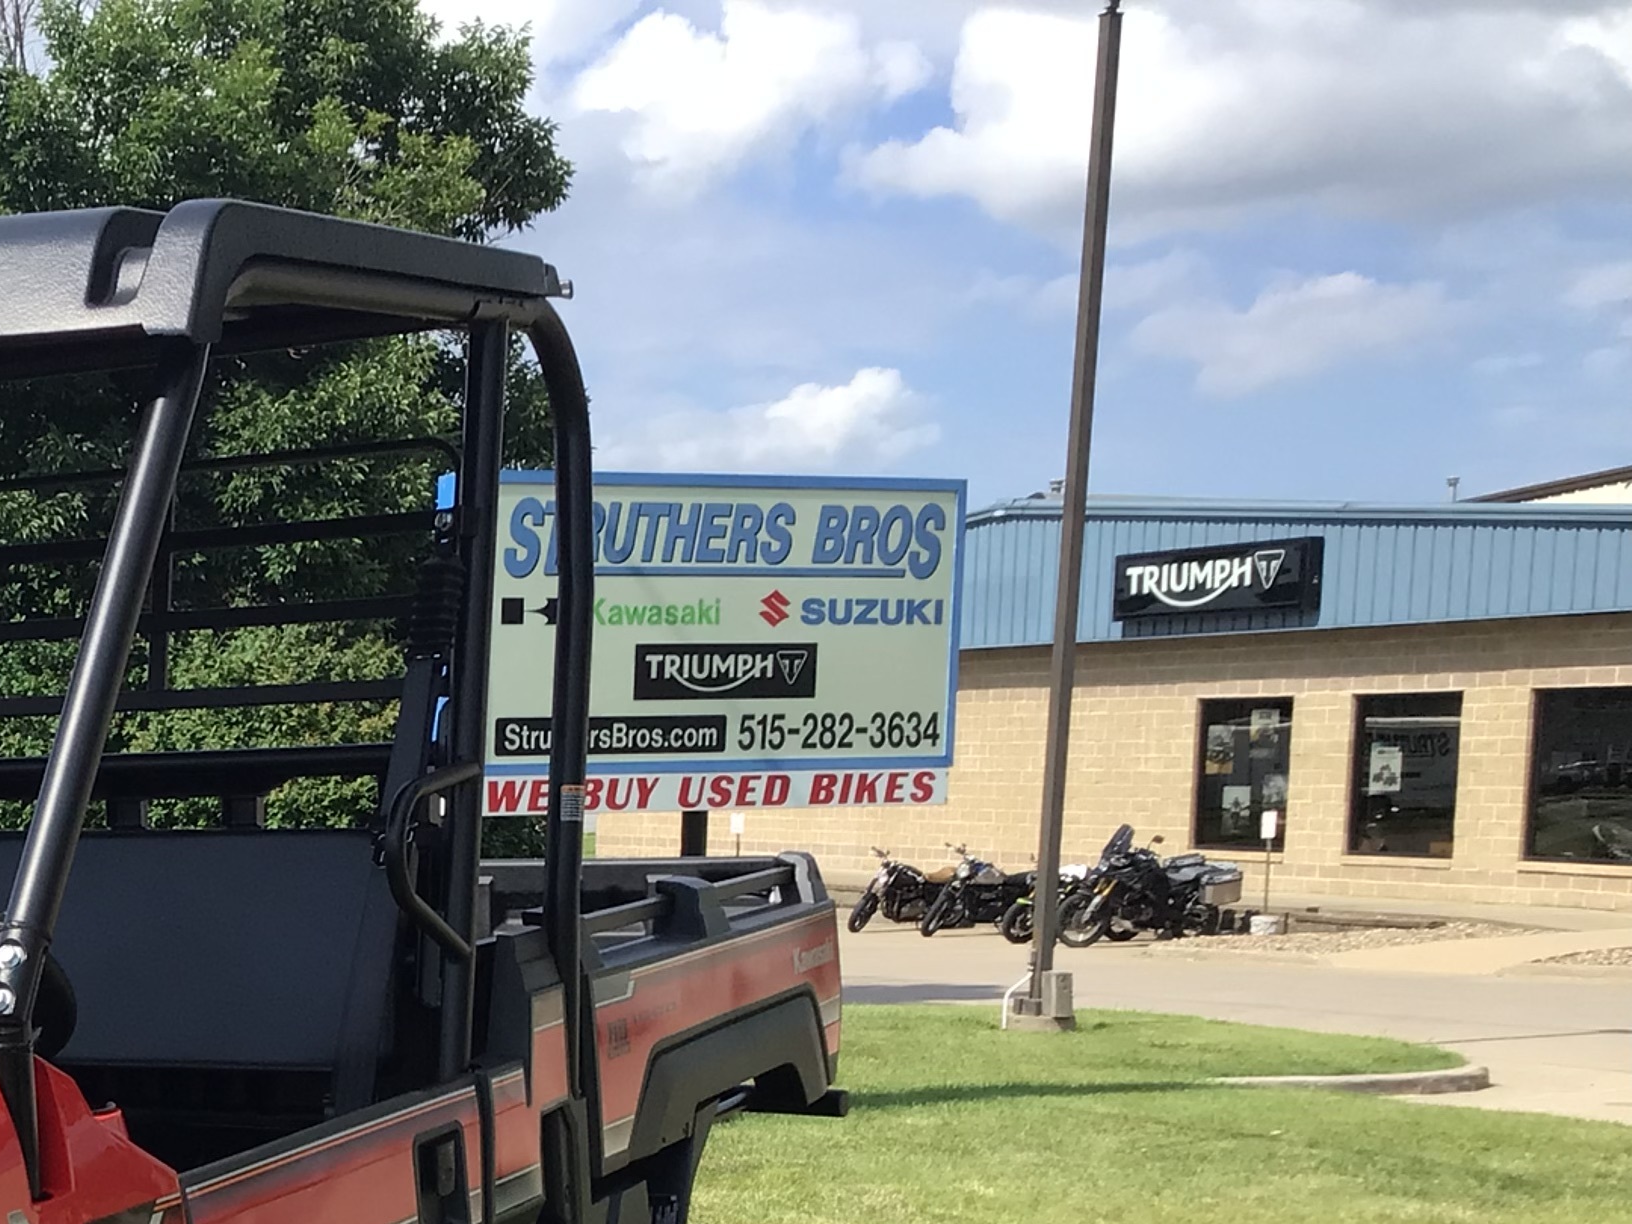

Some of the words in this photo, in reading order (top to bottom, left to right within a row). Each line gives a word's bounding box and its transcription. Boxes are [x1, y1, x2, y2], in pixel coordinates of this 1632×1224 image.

[811, 502, 946, 580] BROS
[1125, 556, 1253, 607] TRIUMPH
[593, 598, 721, 626] Kawasaki
[800, 597, 944, 626] SUZUKI
[644, 652, 774, 692] TRIUMPH
[504, 722, 718, 752] StrursBros.com
[737, 711, 941, 752] 515-282-3634
[487, 780, 549, 813] WE
[583, 776, 660, 811] BUY
[677, 773, 792, 809] USED
[808, 770, 937, 805] BIKES
